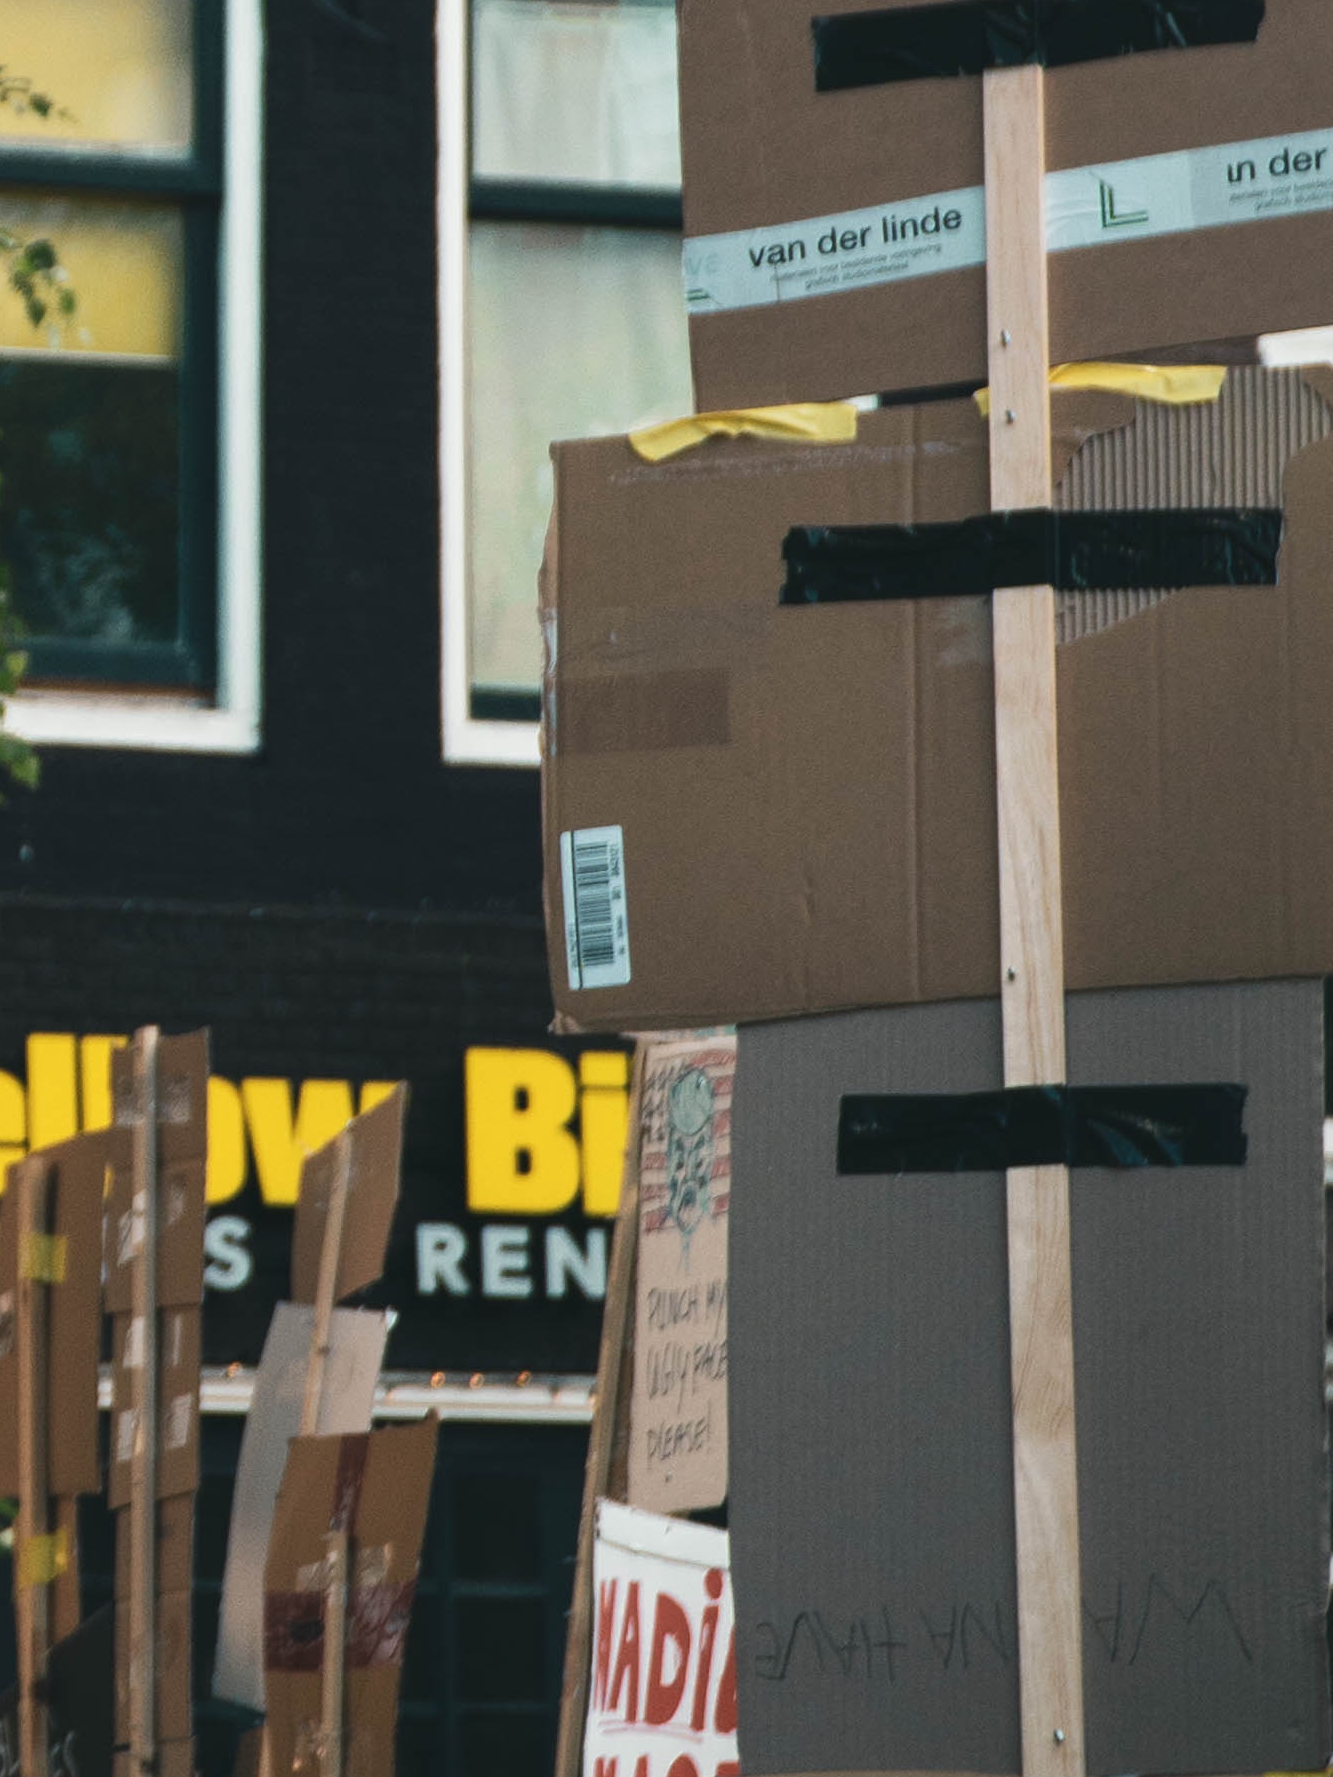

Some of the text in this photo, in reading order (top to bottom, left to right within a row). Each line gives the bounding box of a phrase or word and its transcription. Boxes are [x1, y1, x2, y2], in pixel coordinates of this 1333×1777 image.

[1268, 147, 1327, 177] der
[748, 238, 806, 268] van
[817, 223, 872, 255] der
[881, 206, 963, 243] linde
